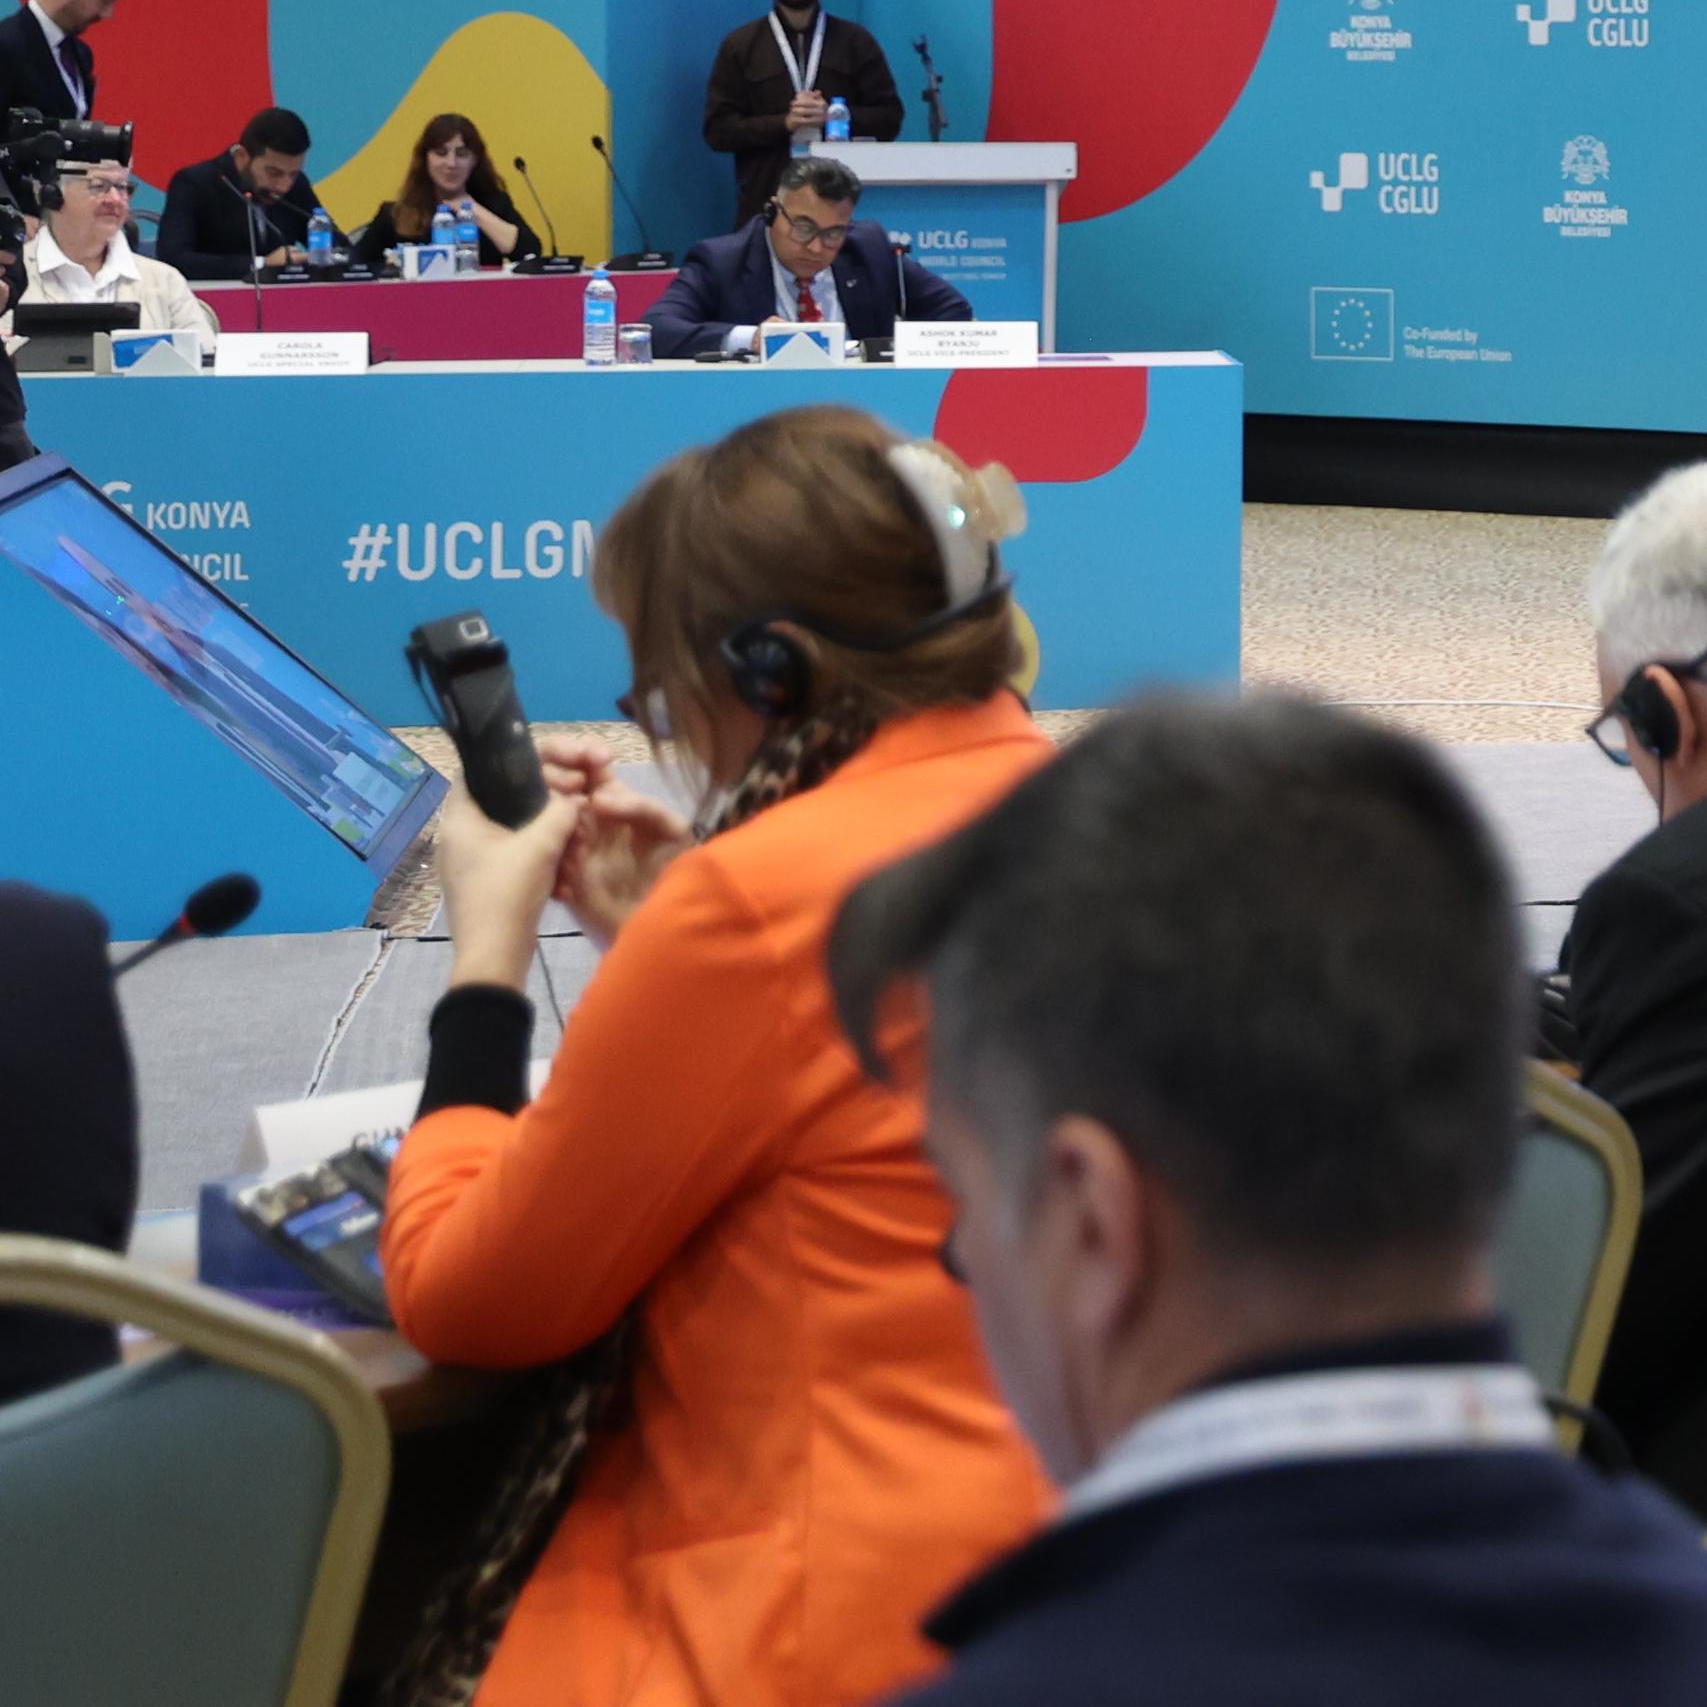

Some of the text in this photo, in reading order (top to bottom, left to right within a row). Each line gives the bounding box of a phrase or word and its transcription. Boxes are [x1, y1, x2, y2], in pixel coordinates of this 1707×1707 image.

[1587, 18, 1649, 47] CGLU
[1379, 153, 1439, 182] UCLG
[1379, 185, 1439, 214] CGLU
[917, 230, 968, 249] UCLG
[144, 501, 250, 532] KONYA
